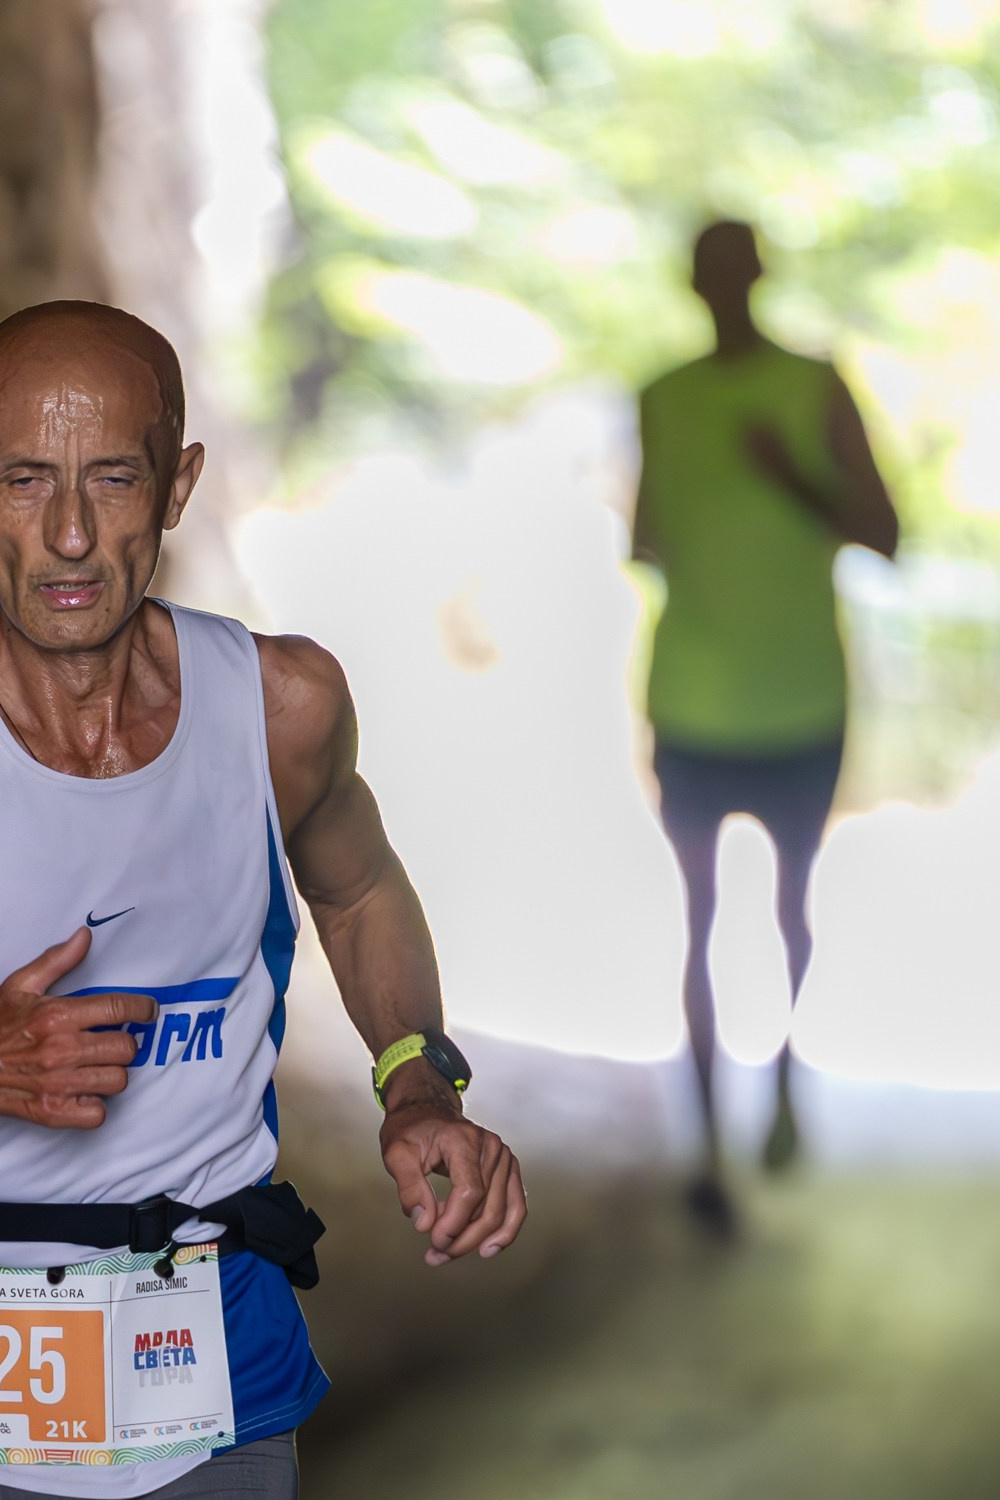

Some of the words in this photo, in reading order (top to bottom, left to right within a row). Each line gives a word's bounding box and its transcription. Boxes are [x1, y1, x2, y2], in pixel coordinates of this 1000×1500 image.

[10, 1288, 47, 1298] SVETA
[50, 1288, 85, 1299] GORA
[136, 1279, 164, 1294] RADISA
[45, 1420, 88, 1439] 21K
